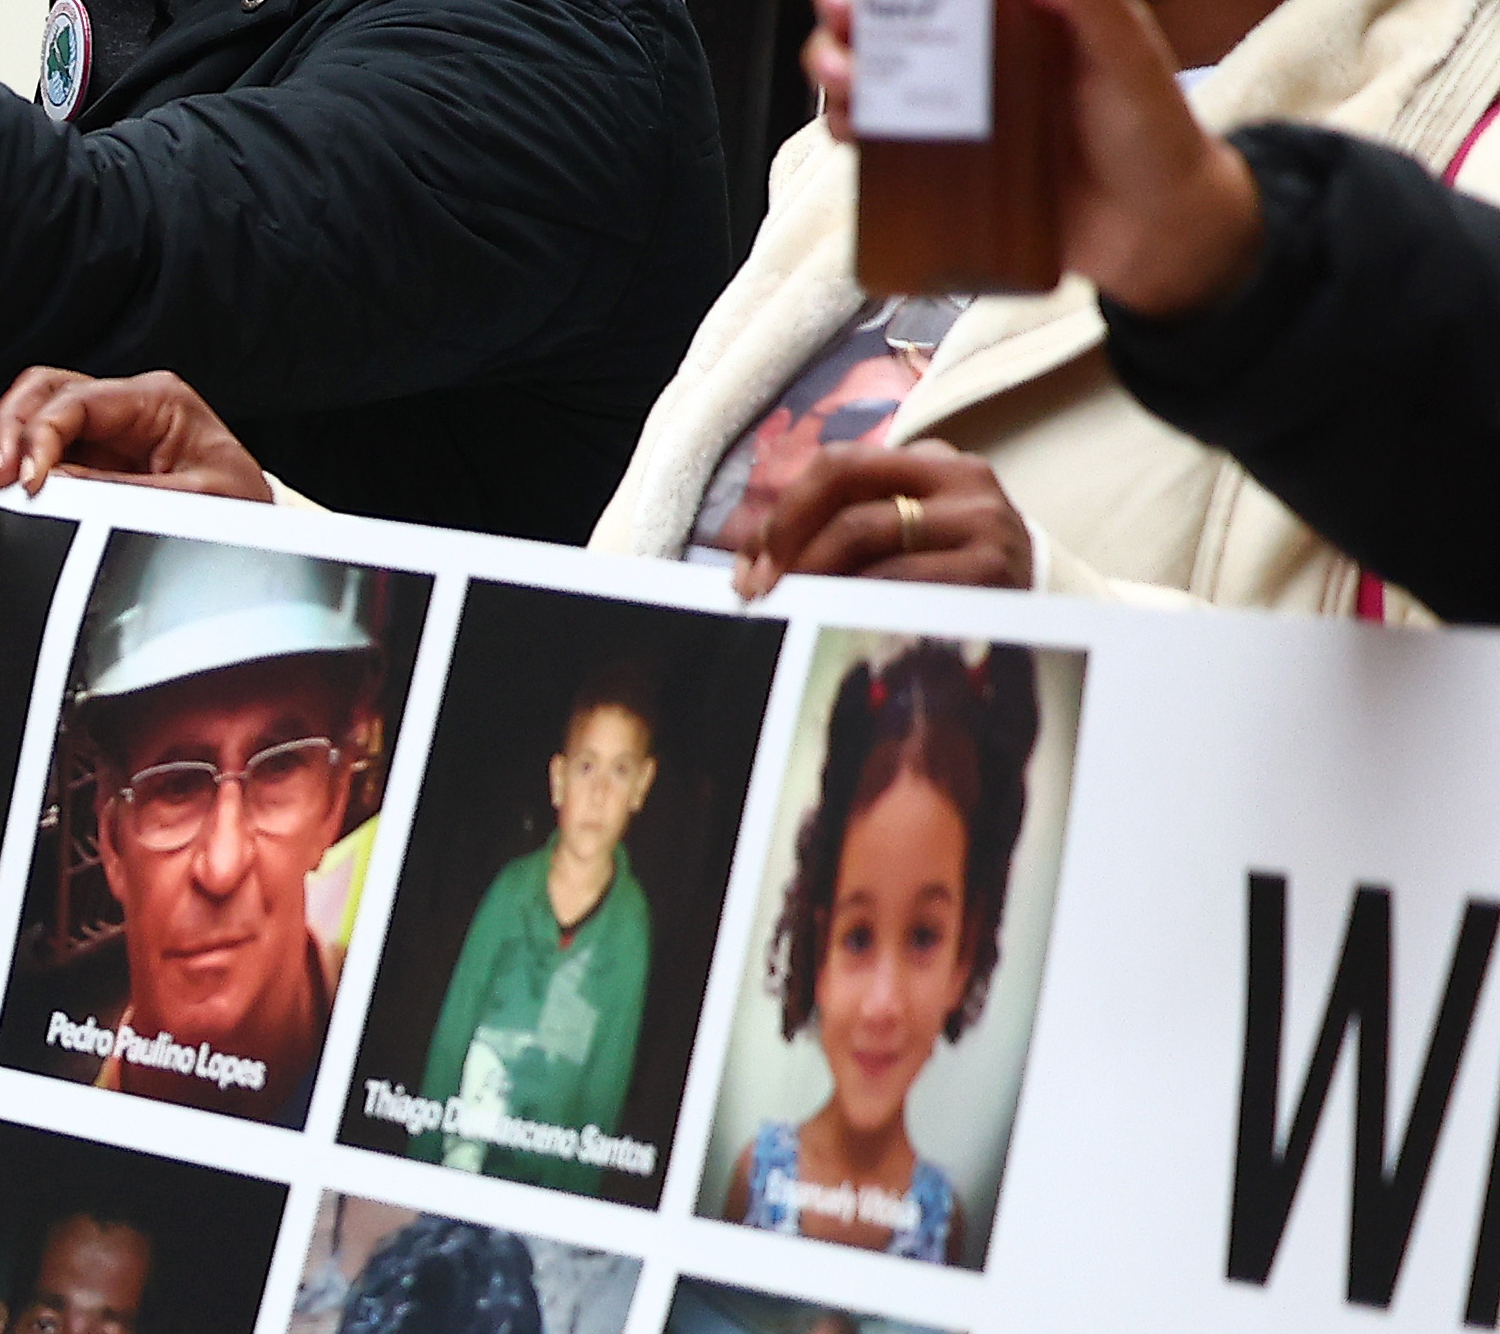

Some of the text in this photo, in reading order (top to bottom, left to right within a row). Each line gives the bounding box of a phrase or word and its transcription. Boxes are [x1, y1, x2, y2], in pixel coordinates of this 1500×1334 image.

[46, 1010, 267, 1091] Pedro Paulino Lopes
[364, 1078, 444, 1135] Thiago
